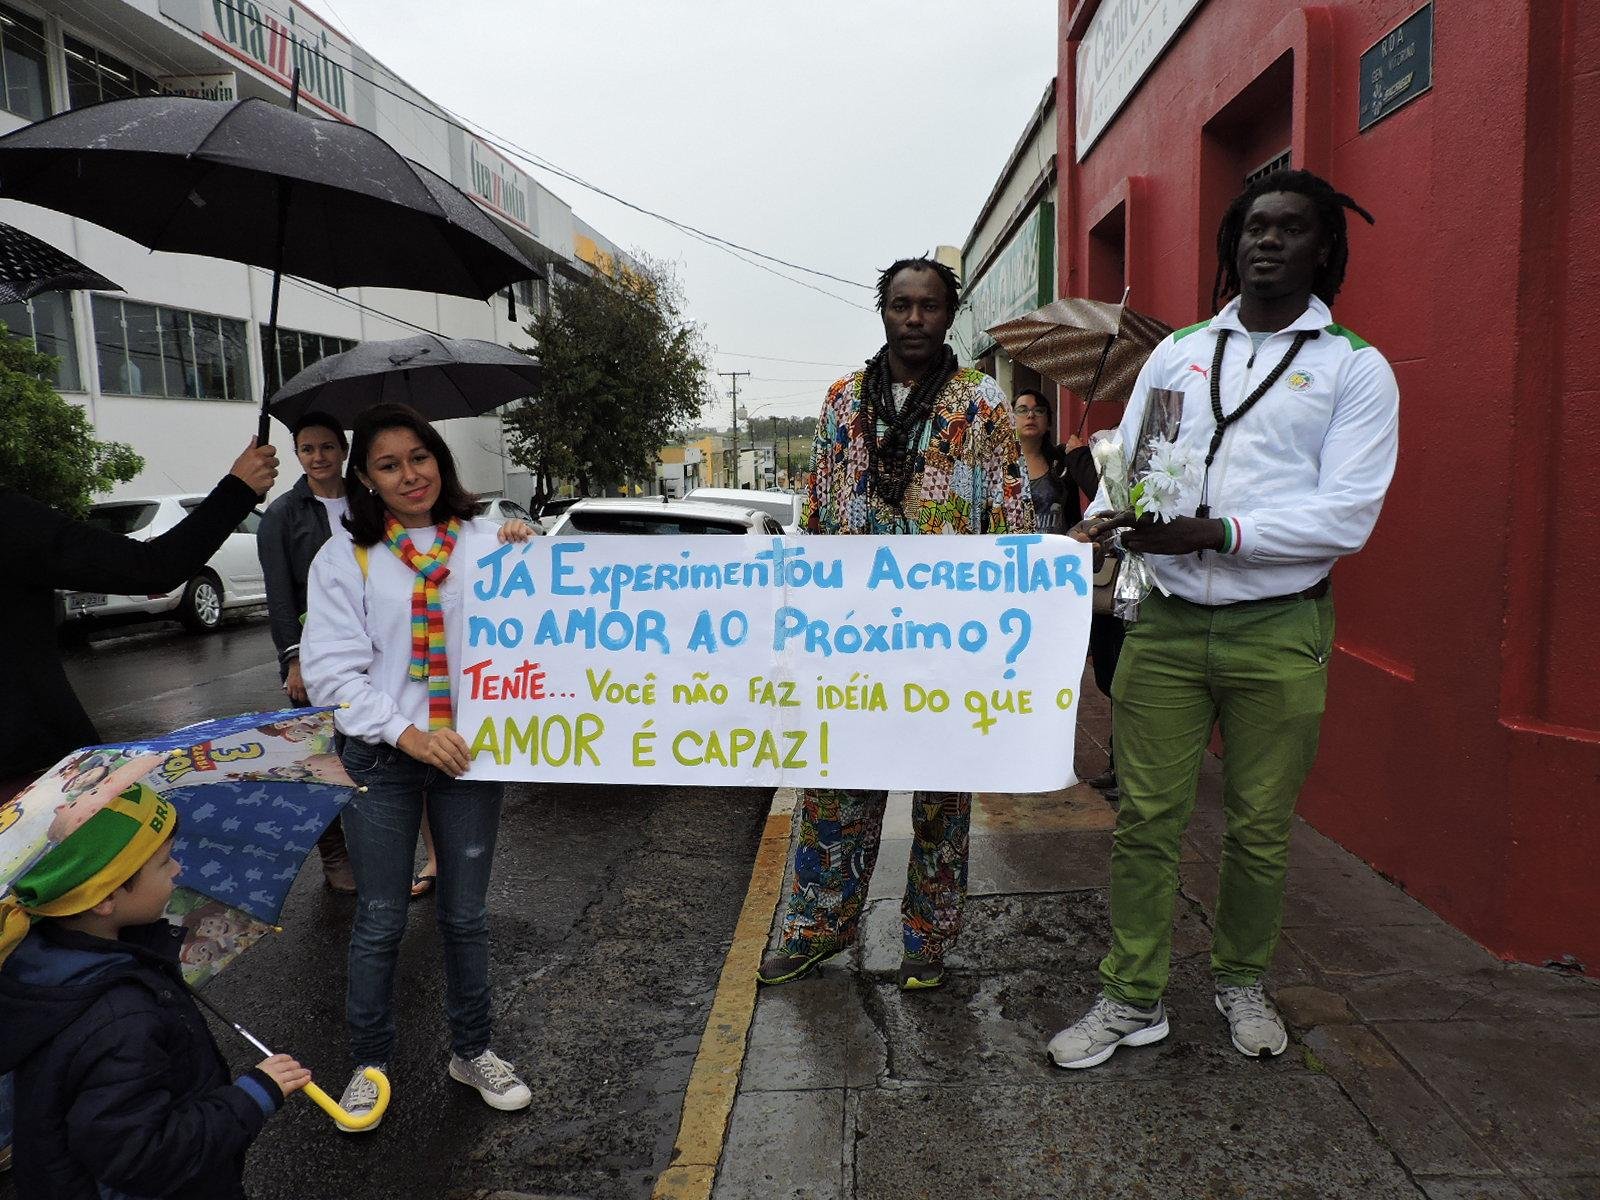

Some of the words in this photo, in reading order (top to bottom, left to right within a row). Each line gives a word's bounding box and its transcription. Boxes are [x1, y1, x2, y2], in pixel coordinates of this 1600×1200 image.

[473, 543, 536, 602] JÁ
[468, 615, 525, 649] no
[534, 607, 671, 655] AMOR
[687, 609, 750, 655] AO
[672, 672, 729, 705] não
[748, 676, 802, 708] FAZ
[470, 712, 606, 767] AMOR
[632, 719, 657, 767] É
